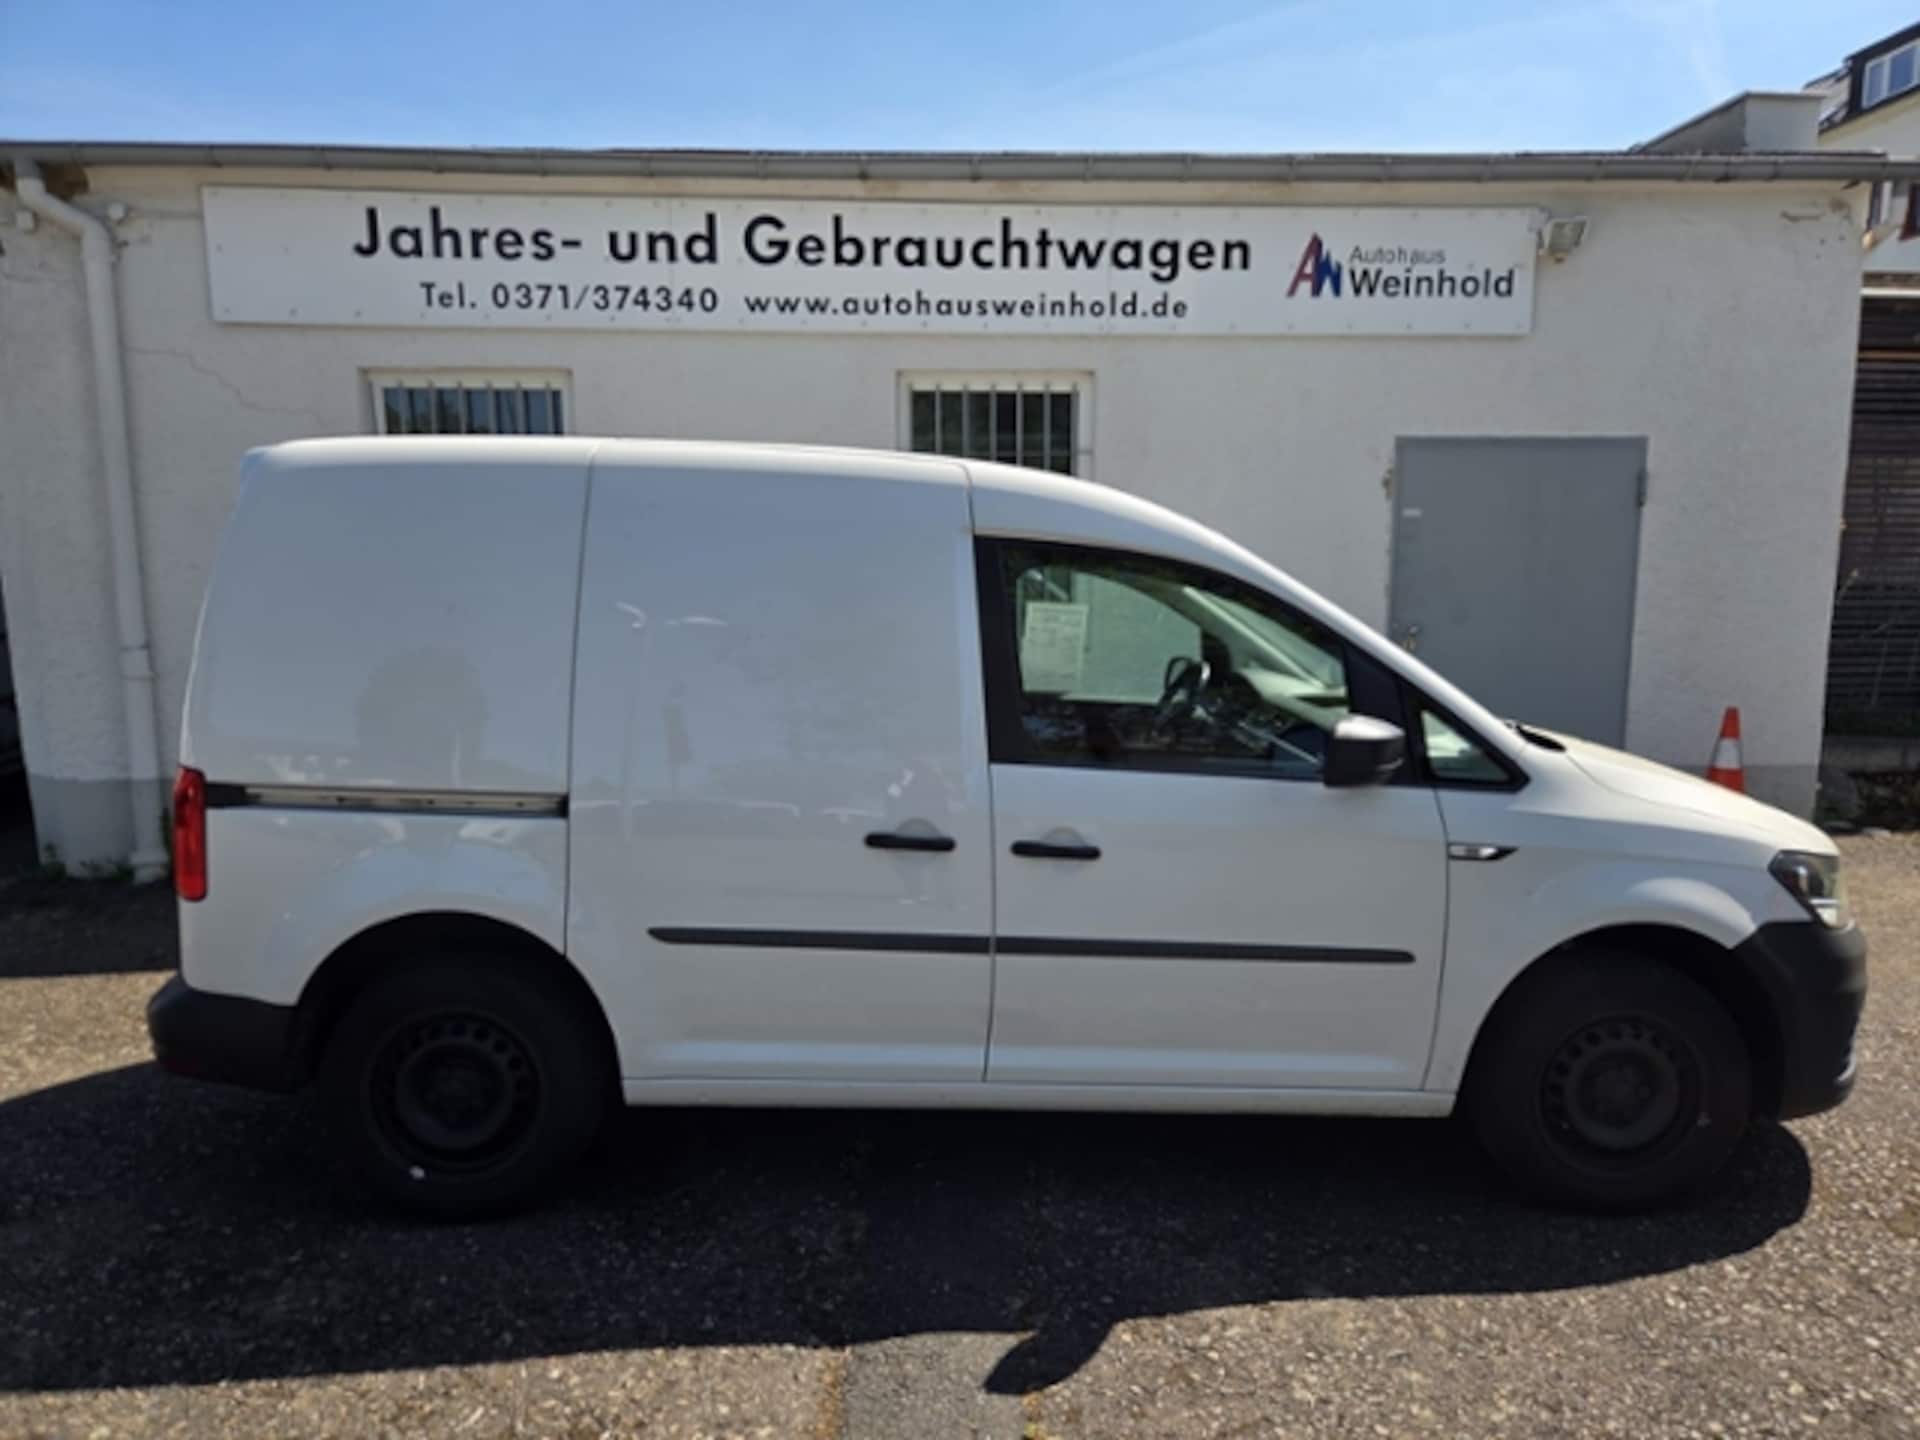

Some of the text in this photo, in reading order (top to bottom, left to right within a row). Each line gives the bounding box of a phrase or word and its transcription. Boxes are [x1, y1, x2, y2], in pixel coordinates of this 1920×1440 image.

[353, 206, 1251, 282] Jahres- und Gebrauchtwagen
[1349, 246, 1446, 265] Autohaus
[1350, 268, 1515, 298] Weinhold
[420, 282, 1188, 319] Tel. 0371/374340 www.autohausweinhold.de
